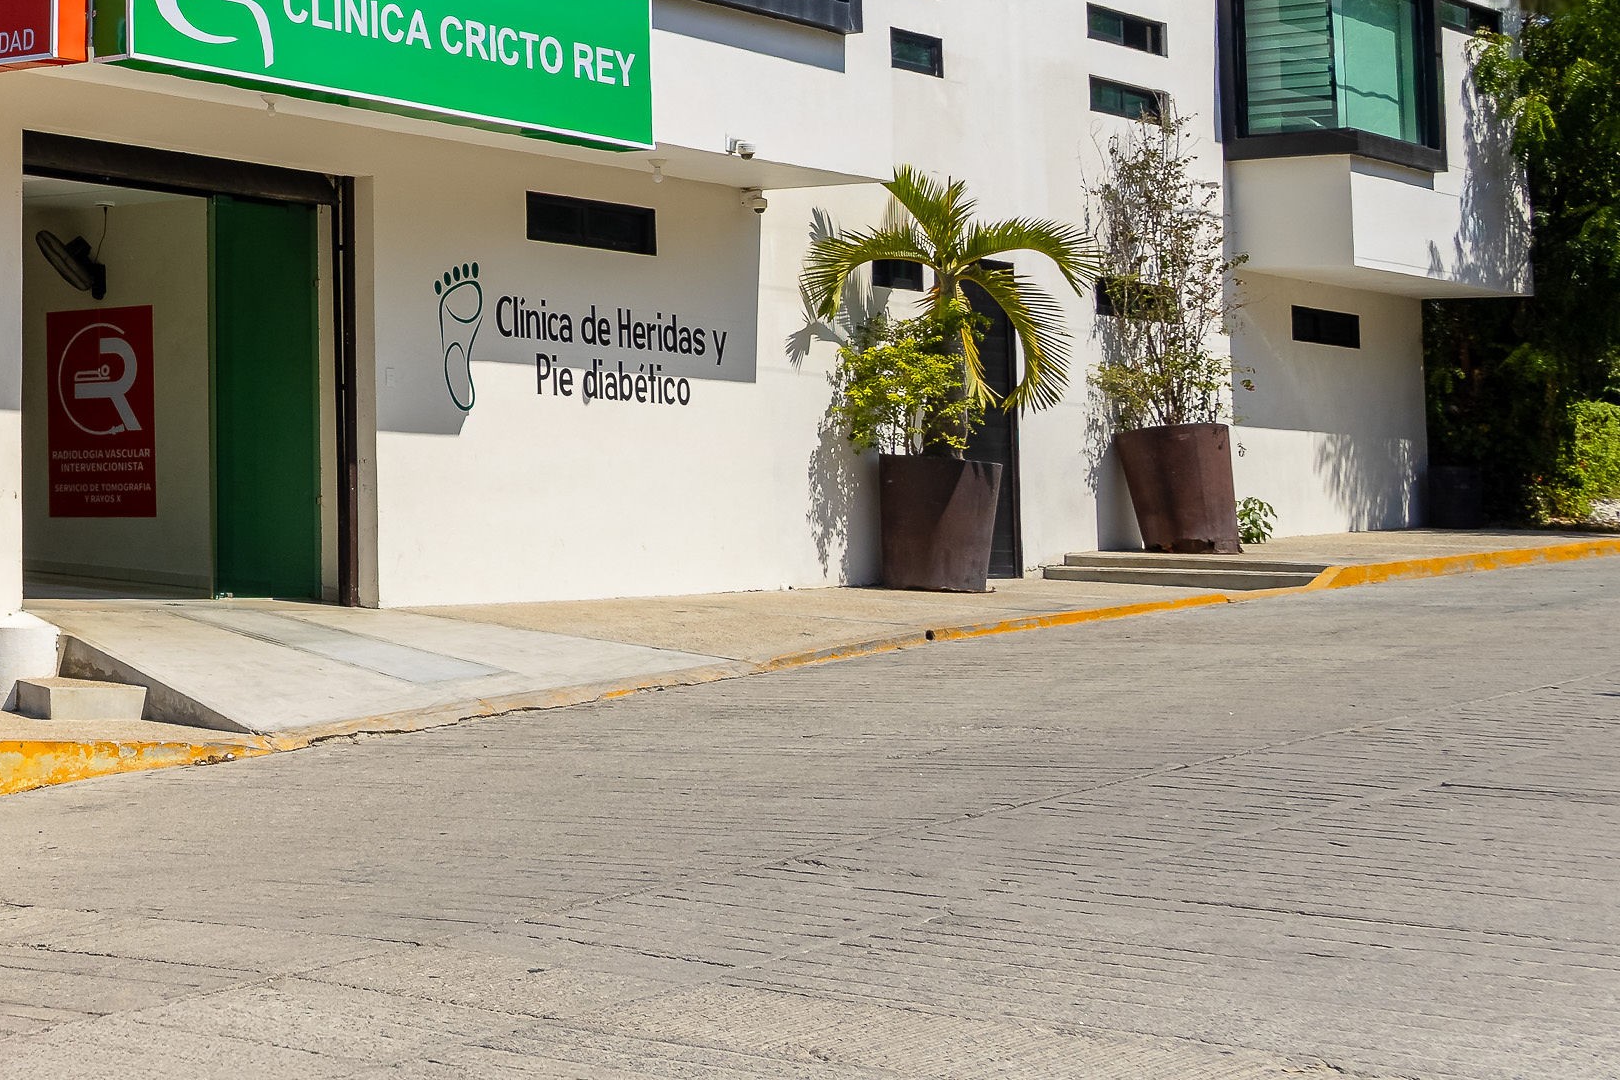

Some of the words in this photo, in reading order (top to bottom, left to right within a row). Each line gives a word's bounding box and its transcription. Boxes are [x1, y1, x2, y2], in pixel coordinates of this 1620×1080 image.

[439, 15, 562, 75] CRICTO
[573, 42, 635, 87] REY
[495, 294, 573, 344] Clínica
[581, 304, 611, 347] de
[617, 307, 706, 357] Heridas
[712, 329, 727, 366] y
[536, 352, 574, 398] Pie
[582, 358, 691, 406] diabético
[105, 448, 151, 459] VASCULAR
[60, 461, 144, 473] INTERVENCIONISTA
[54, 483, 89, 492] SERVICIO
[90, 483, 100, 492] DE
[91, 494, 115, 503] RAYOS
